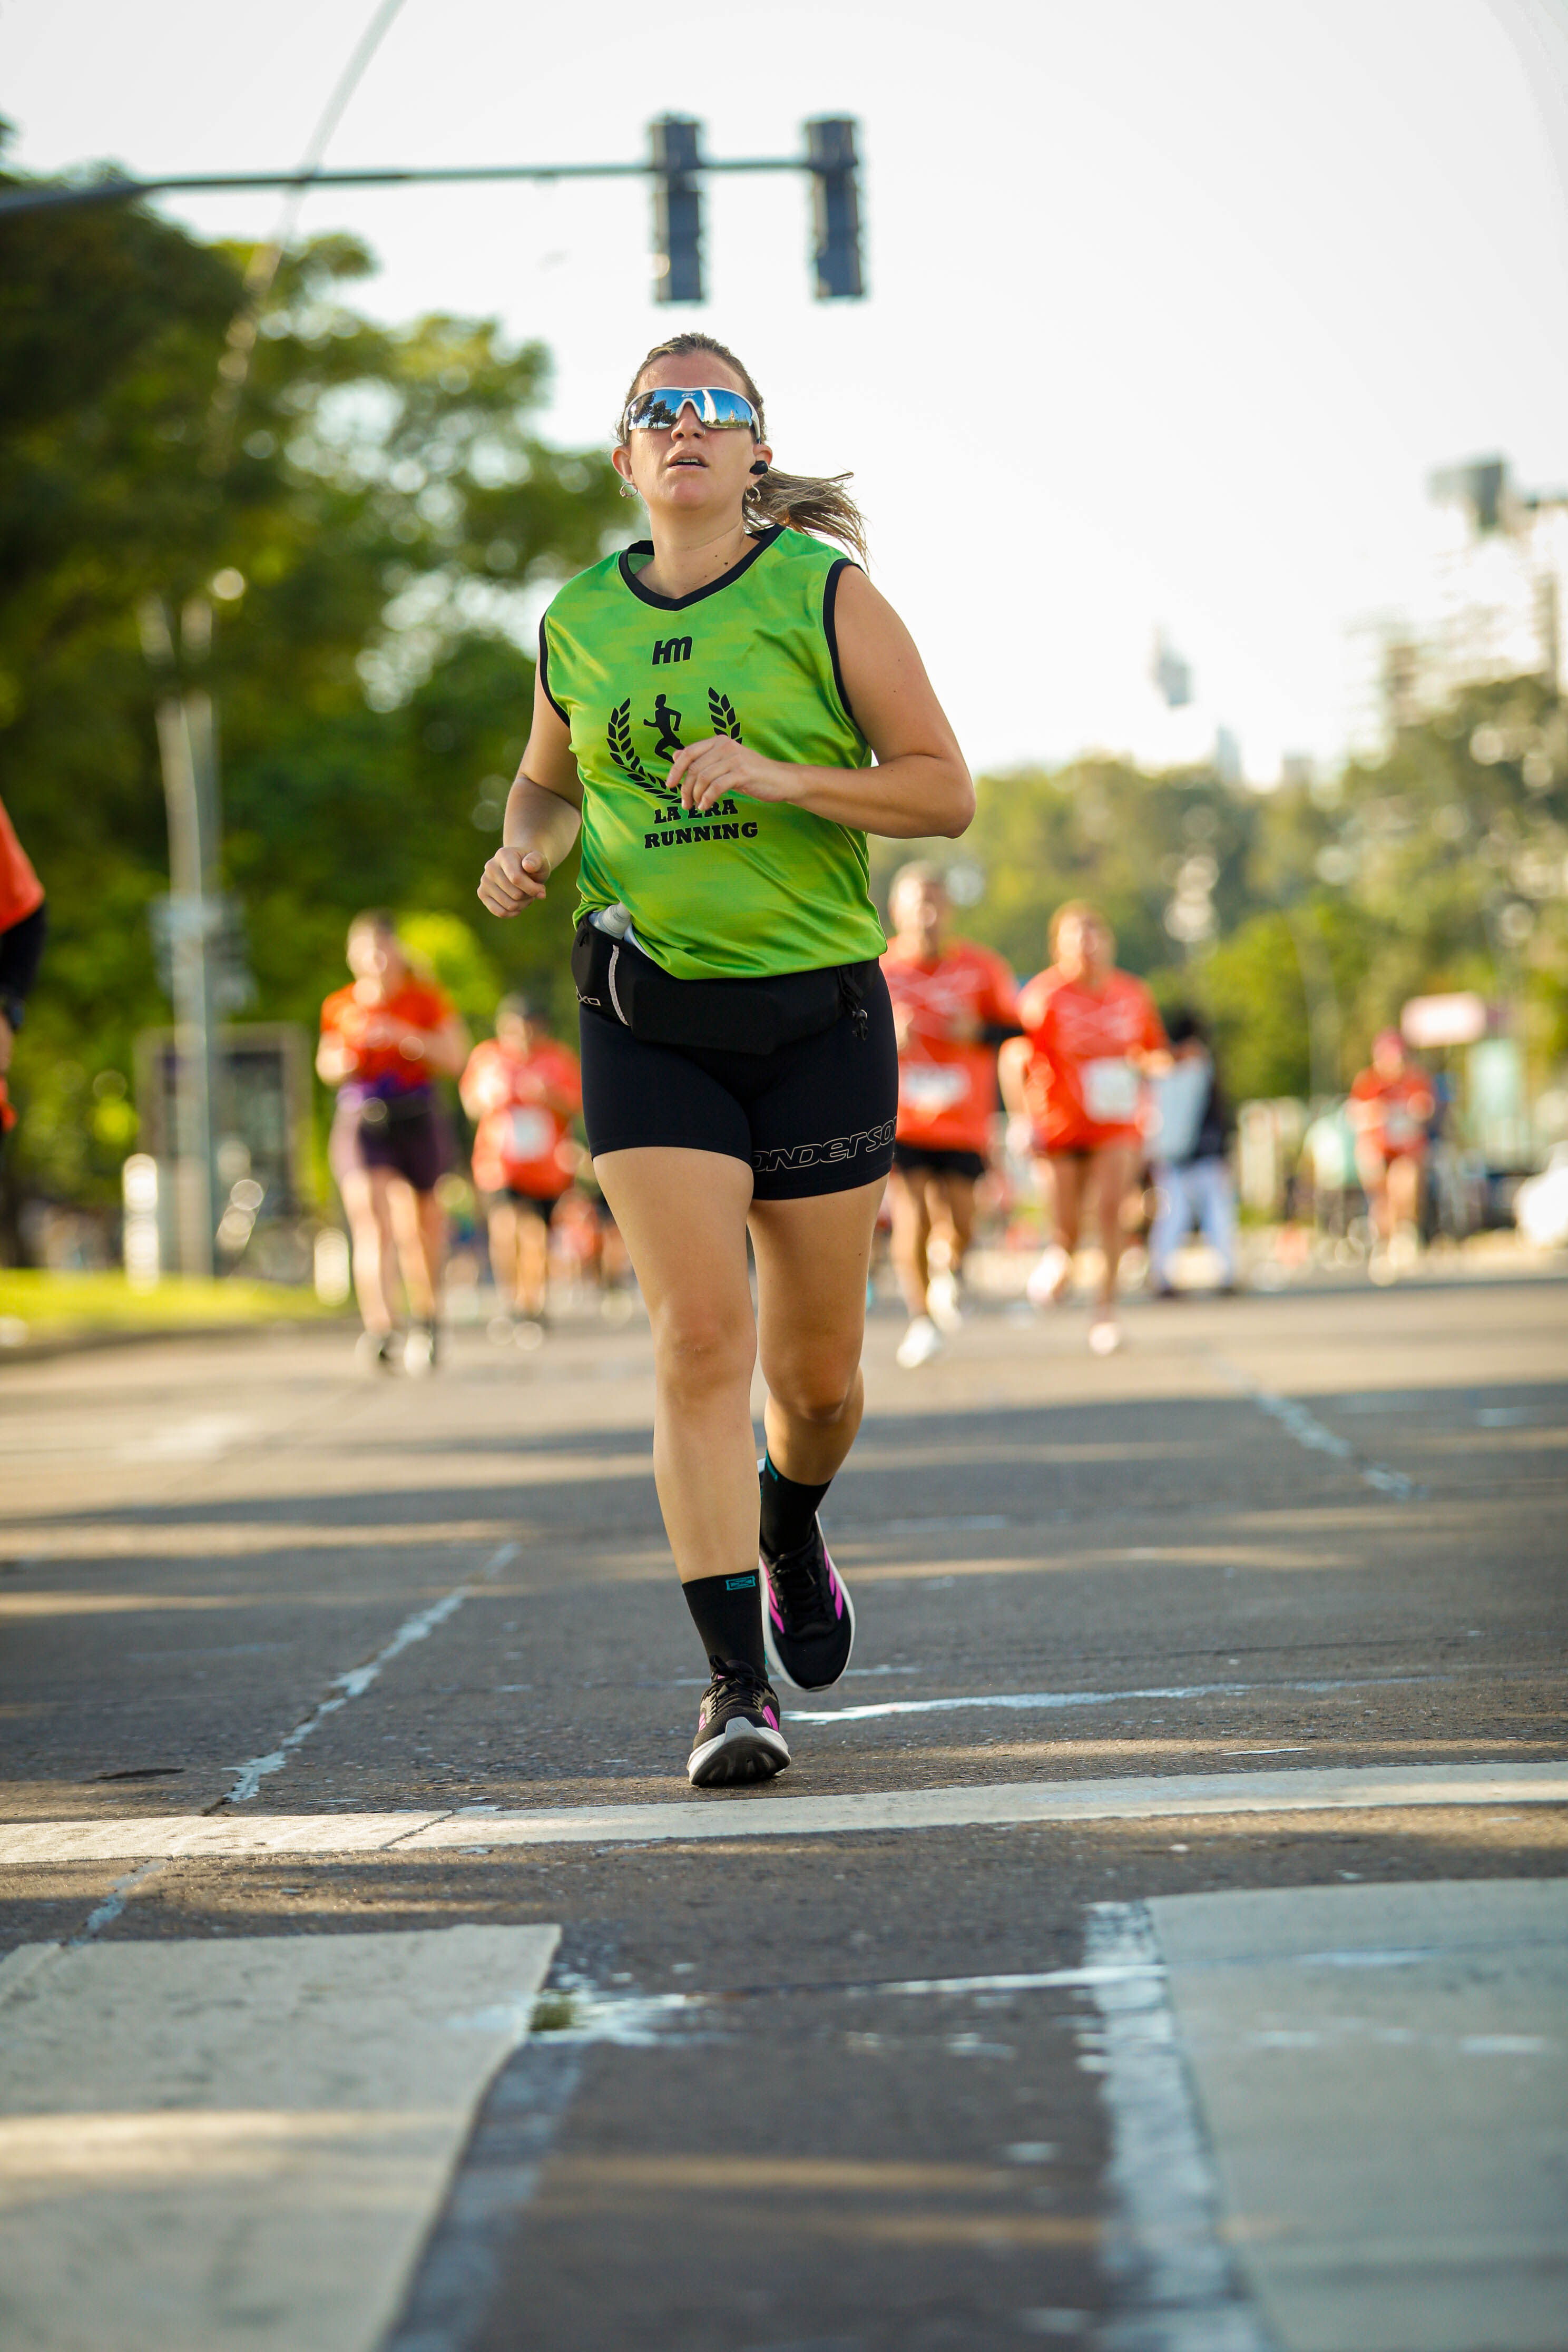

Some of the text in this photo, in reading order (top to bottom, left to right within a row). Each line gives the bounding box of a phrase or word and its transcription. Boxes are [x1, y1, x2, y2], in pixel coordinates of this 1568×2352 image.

[654, 798, 738, 824] LA ERA
[644, 821, 758, 849] RUNNING
